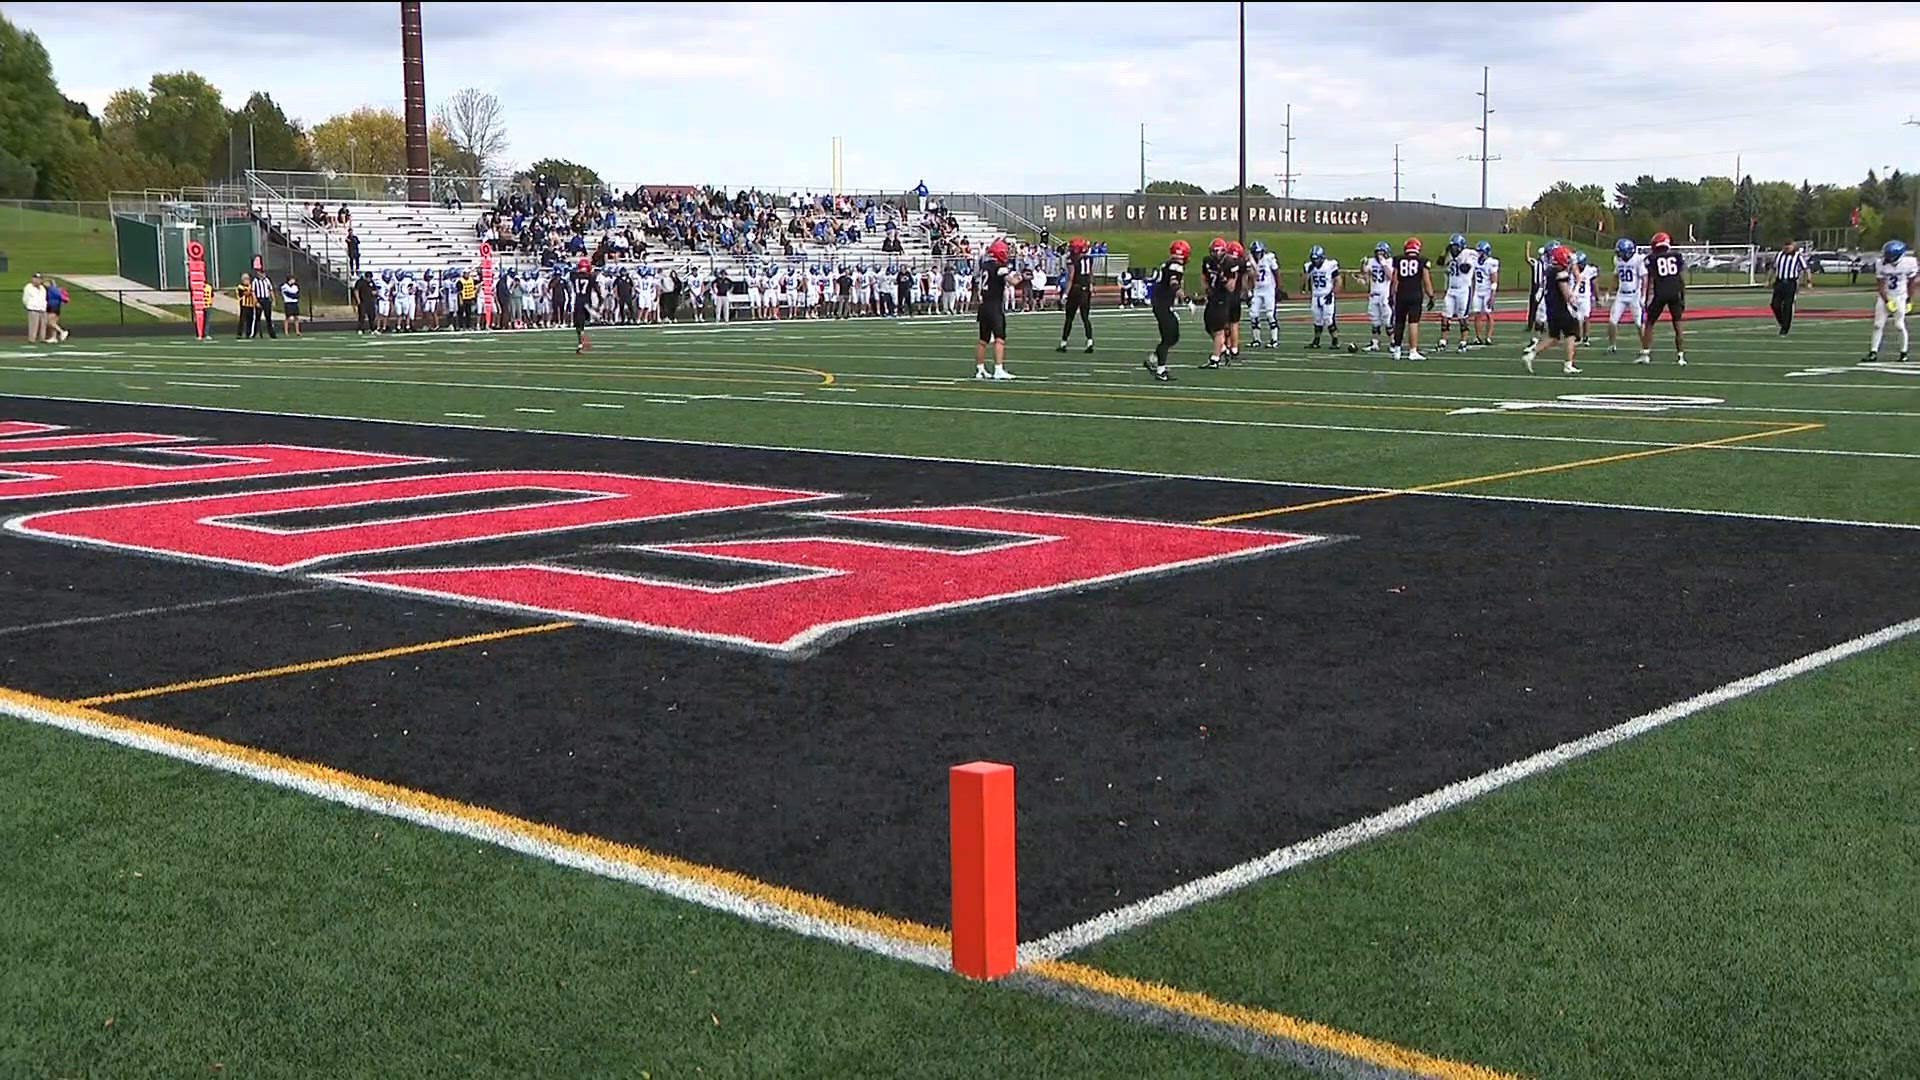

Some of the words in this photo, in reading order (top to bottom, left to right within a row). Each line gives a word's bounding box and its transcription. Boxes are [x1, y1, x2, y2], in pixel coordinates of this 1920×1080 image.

[1065, 204, 1115, 220] HOME
[1126, 204, 1147, 220] OF
[1158, 205, 1188, 221] THE
[1199, 206, 1240, 221] EDEN
[1249, 207, 1307, 223] PRAIRIE
[1314, 210, 1358, 225] EAGLES
[1080, 257, 1090, 275] 11
[1399, 259, 1419, 276] 88
[1657, 257, 1678, 276] 86
[1312, 273, 1327, 288] 55
[1618, 269, 1633, 282] 20
[1888, 275, 1898, 290] 3
[575, 278, 589, 295] 17
